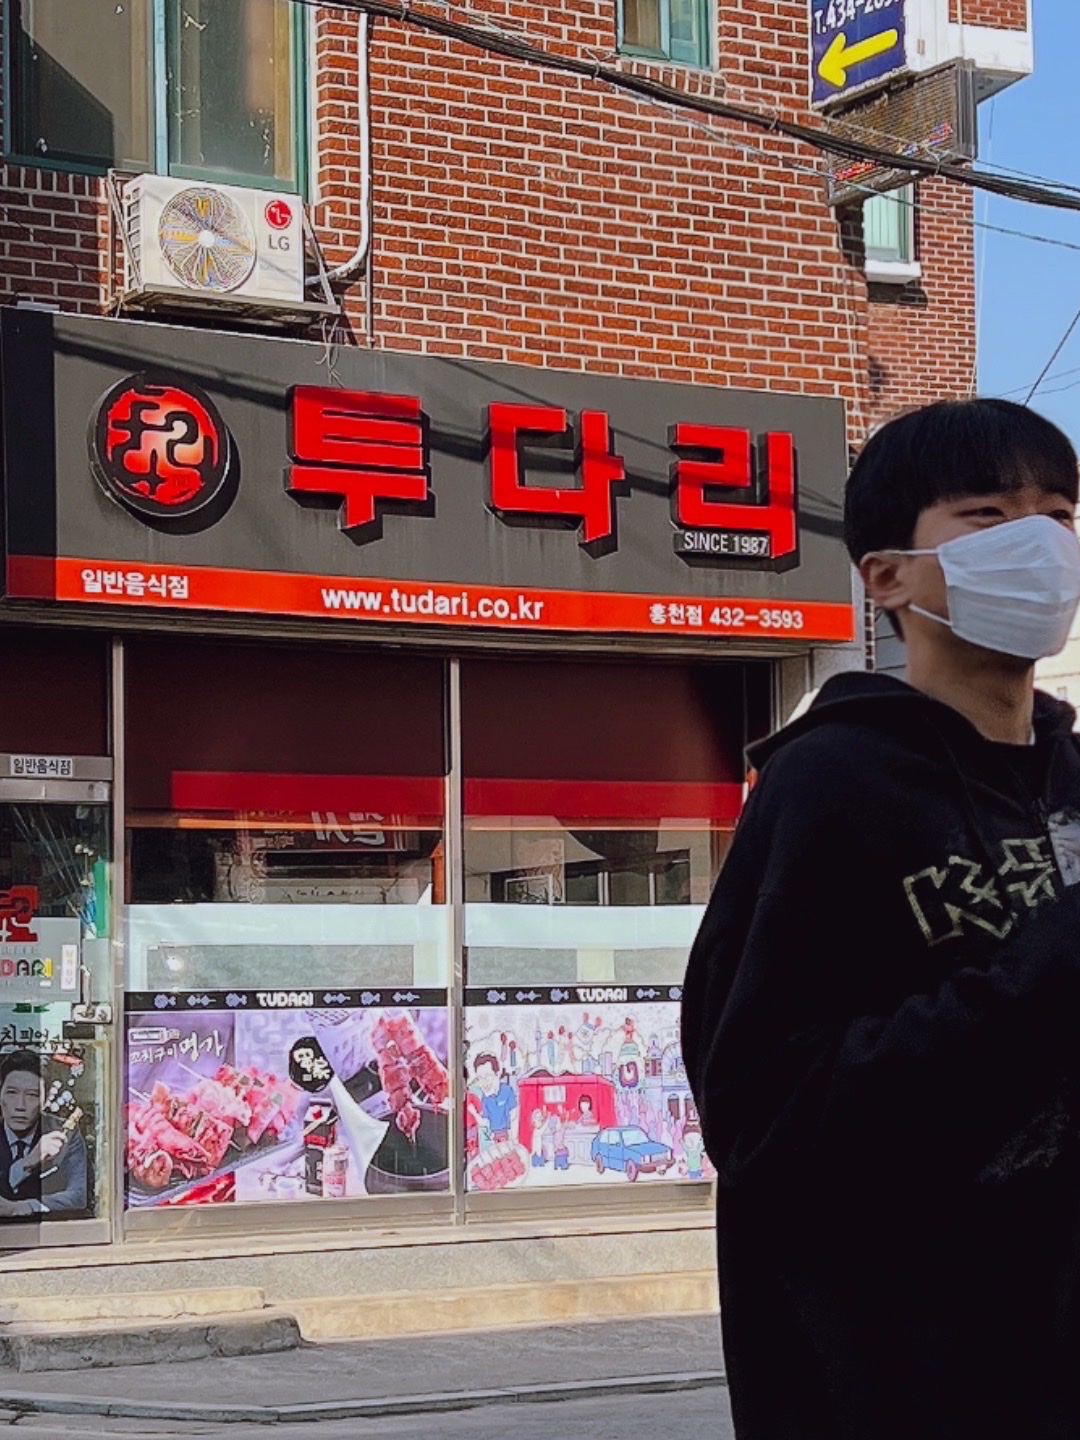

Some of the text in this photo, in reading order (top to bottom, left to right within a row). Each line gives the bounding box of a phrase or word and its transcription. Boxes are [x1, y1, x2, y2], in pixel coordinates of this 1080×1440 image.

[268, 234, 290, 251] LG
[288, 384, 797, 560] 투다리
[684, 532, 770, 554] SINCE 1987
[81, 569, 189, 599] 일반음식점
[321, 585, 544, 621] www.tudari.co.kr
[649, 603, 804, 629] 홍천점 432-3593
[13, 758, 71, 775] 일반음식점
[256, 992, 314, 1007] TUDARI
[576, 987, 628, 1002] TUDARI
